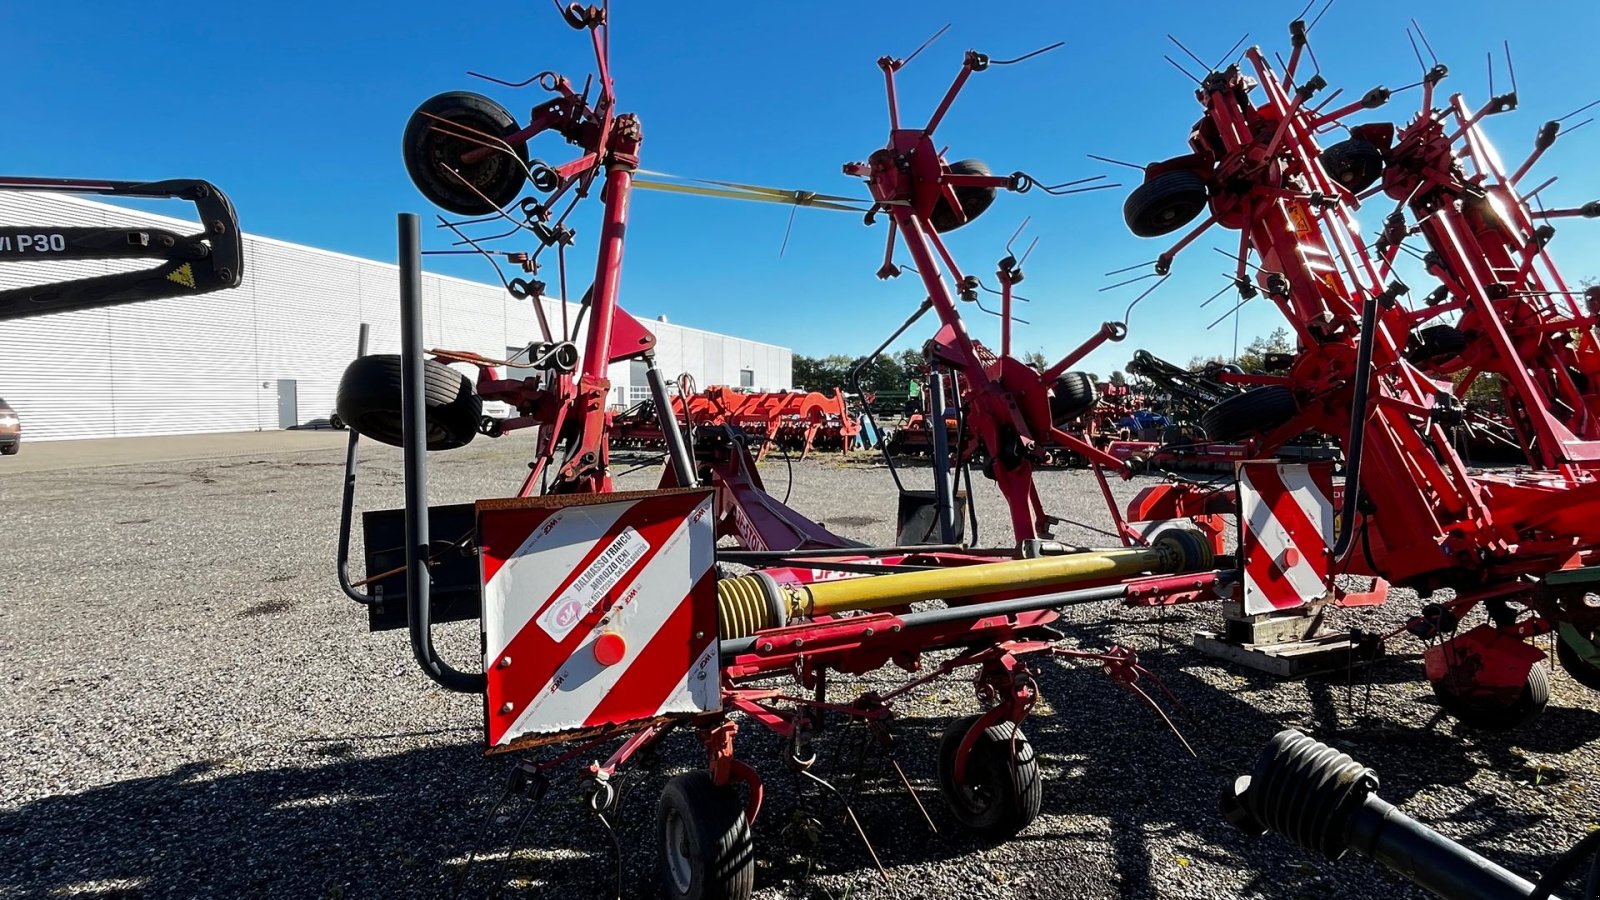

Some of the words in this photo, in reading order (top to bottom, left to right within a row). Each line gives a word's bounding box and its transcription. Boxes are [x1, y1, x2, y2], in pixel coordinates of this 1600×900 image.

[16, 233, 66, 252] P30
[573, 555, 609, 592] DALMASSO
[605, 531, 632, 559] FRANCO
[590, 561, 618, 591] MOROZZO
